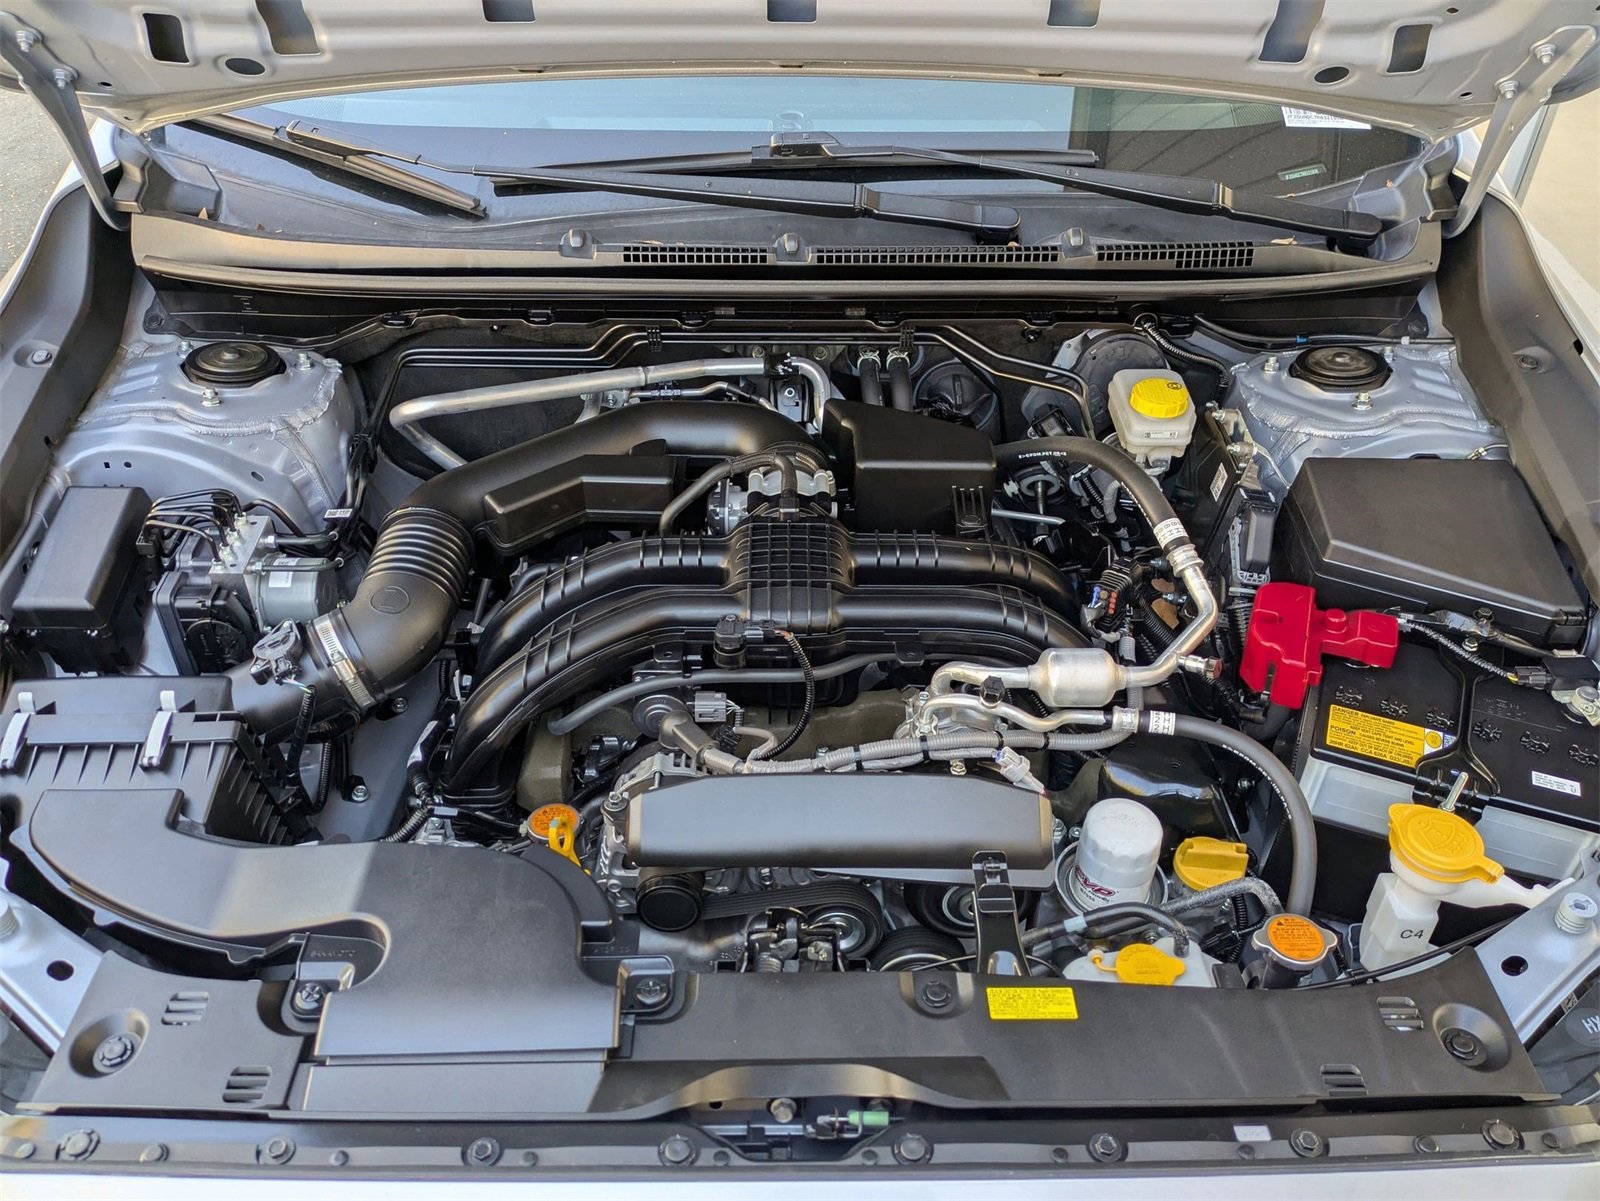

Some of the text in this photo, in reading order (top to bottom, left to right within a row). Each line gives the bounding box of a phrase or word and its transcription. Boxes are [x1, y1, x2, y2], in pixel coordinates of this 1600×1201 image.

[1332, 706, 1359, 716] DANGER
[1330, 724, 1356, 735] POISON
[1400, 929, 1424, 939] C4
